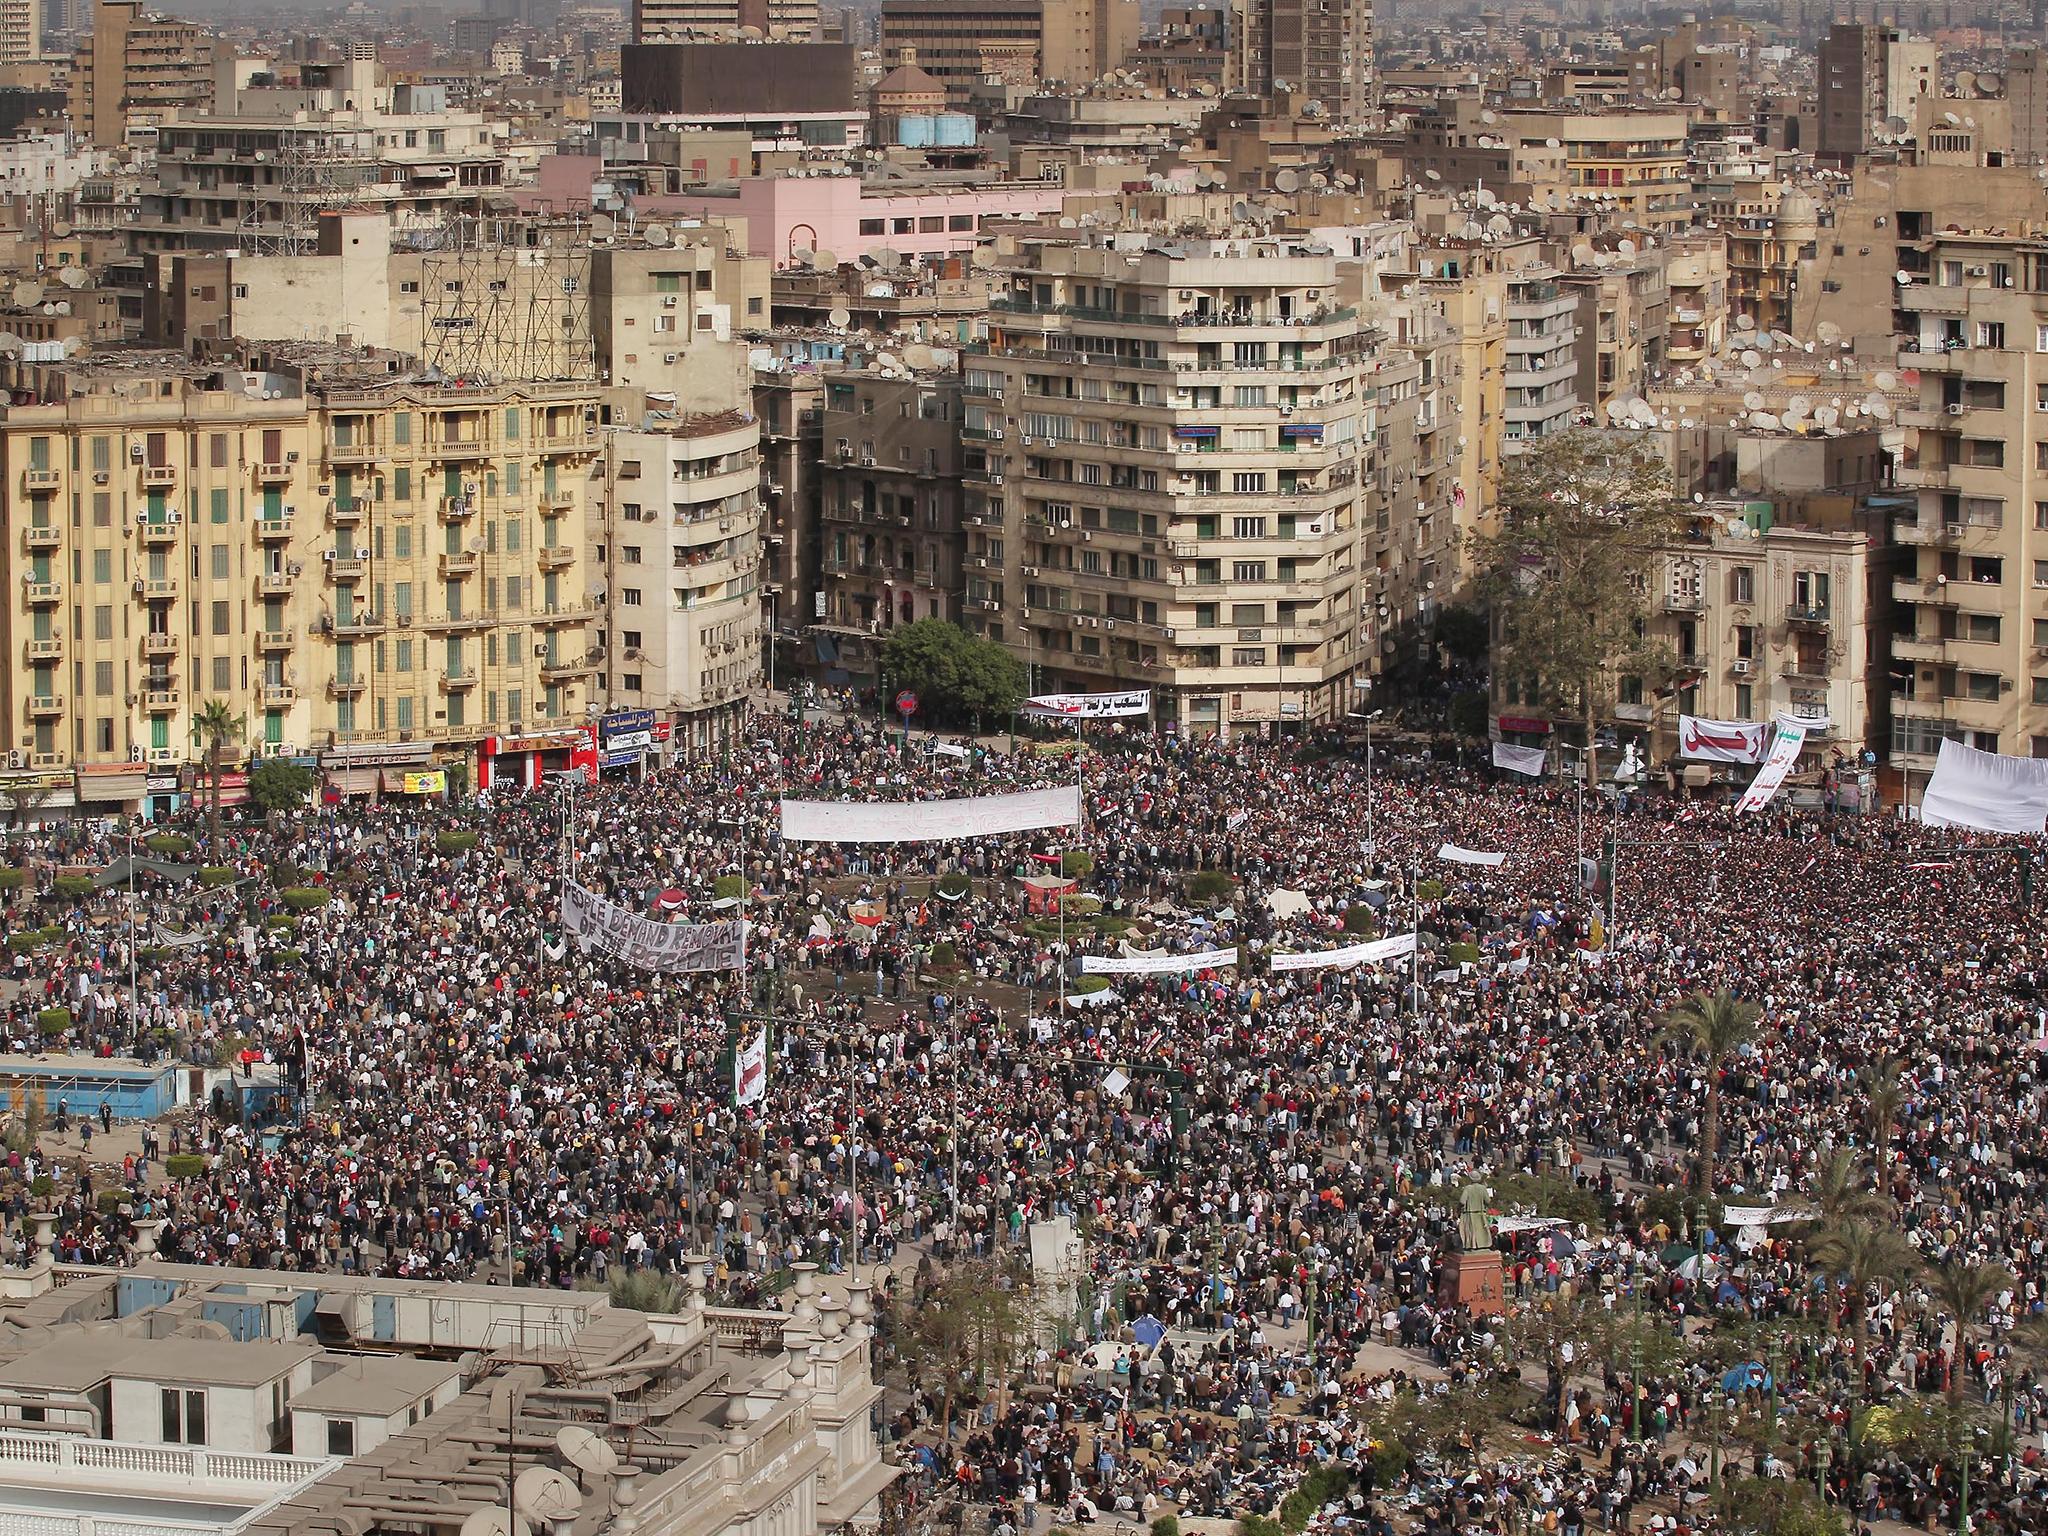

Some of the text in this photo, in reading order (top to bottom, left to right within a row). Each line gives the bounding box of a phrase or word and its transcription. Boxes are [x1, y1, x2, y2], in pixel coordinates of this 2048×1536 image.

[1685, 720, 1767, 761] ارحل
[564, 878, 741, 949] PEOPLE DEMAND REMOVAL
[580, 917, 595, 938] OF
[602, 931, 626, 954] THE
